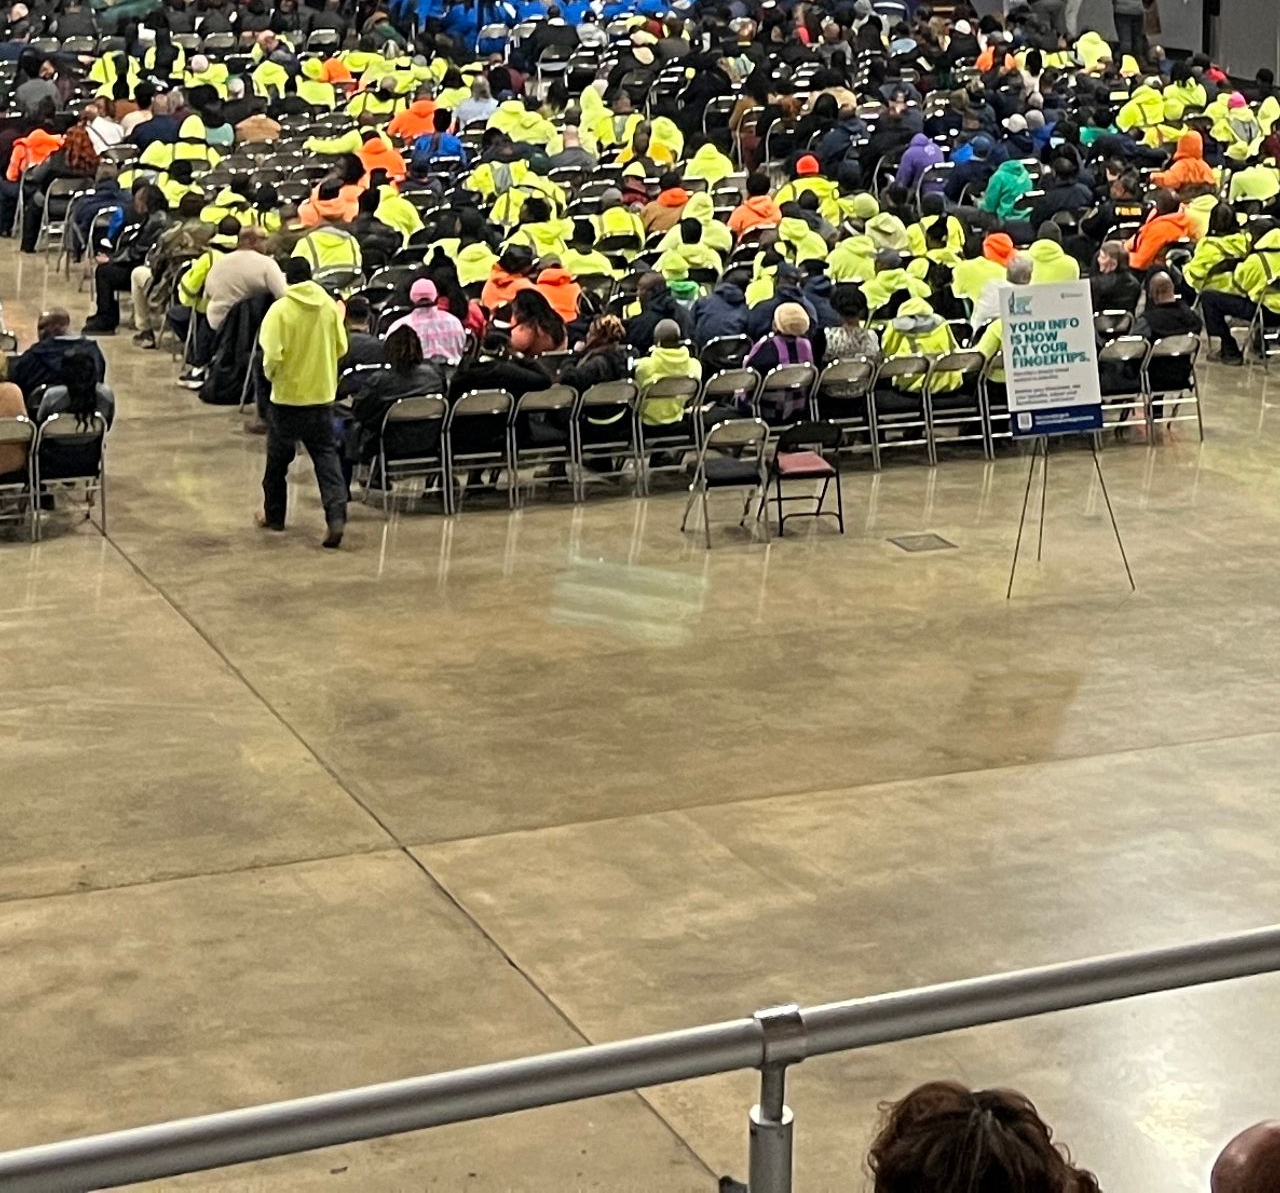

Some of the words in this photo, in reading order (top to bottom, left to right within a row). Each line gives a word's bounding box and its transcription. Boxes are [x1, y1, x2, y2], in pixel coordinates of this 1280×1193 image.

[1009, 320, 1046, 334] YOUR
[1048, 317, 1079, 330] INFO
[1010, 334, 1022, 345] IS
[1024, 330, 1058, 344] NOW
[1012, 344, 1028, 357] AT
[1031, 341, 1068, 354] YOUR
[1012, 351, 1091, 369] FINGERTIPS.
